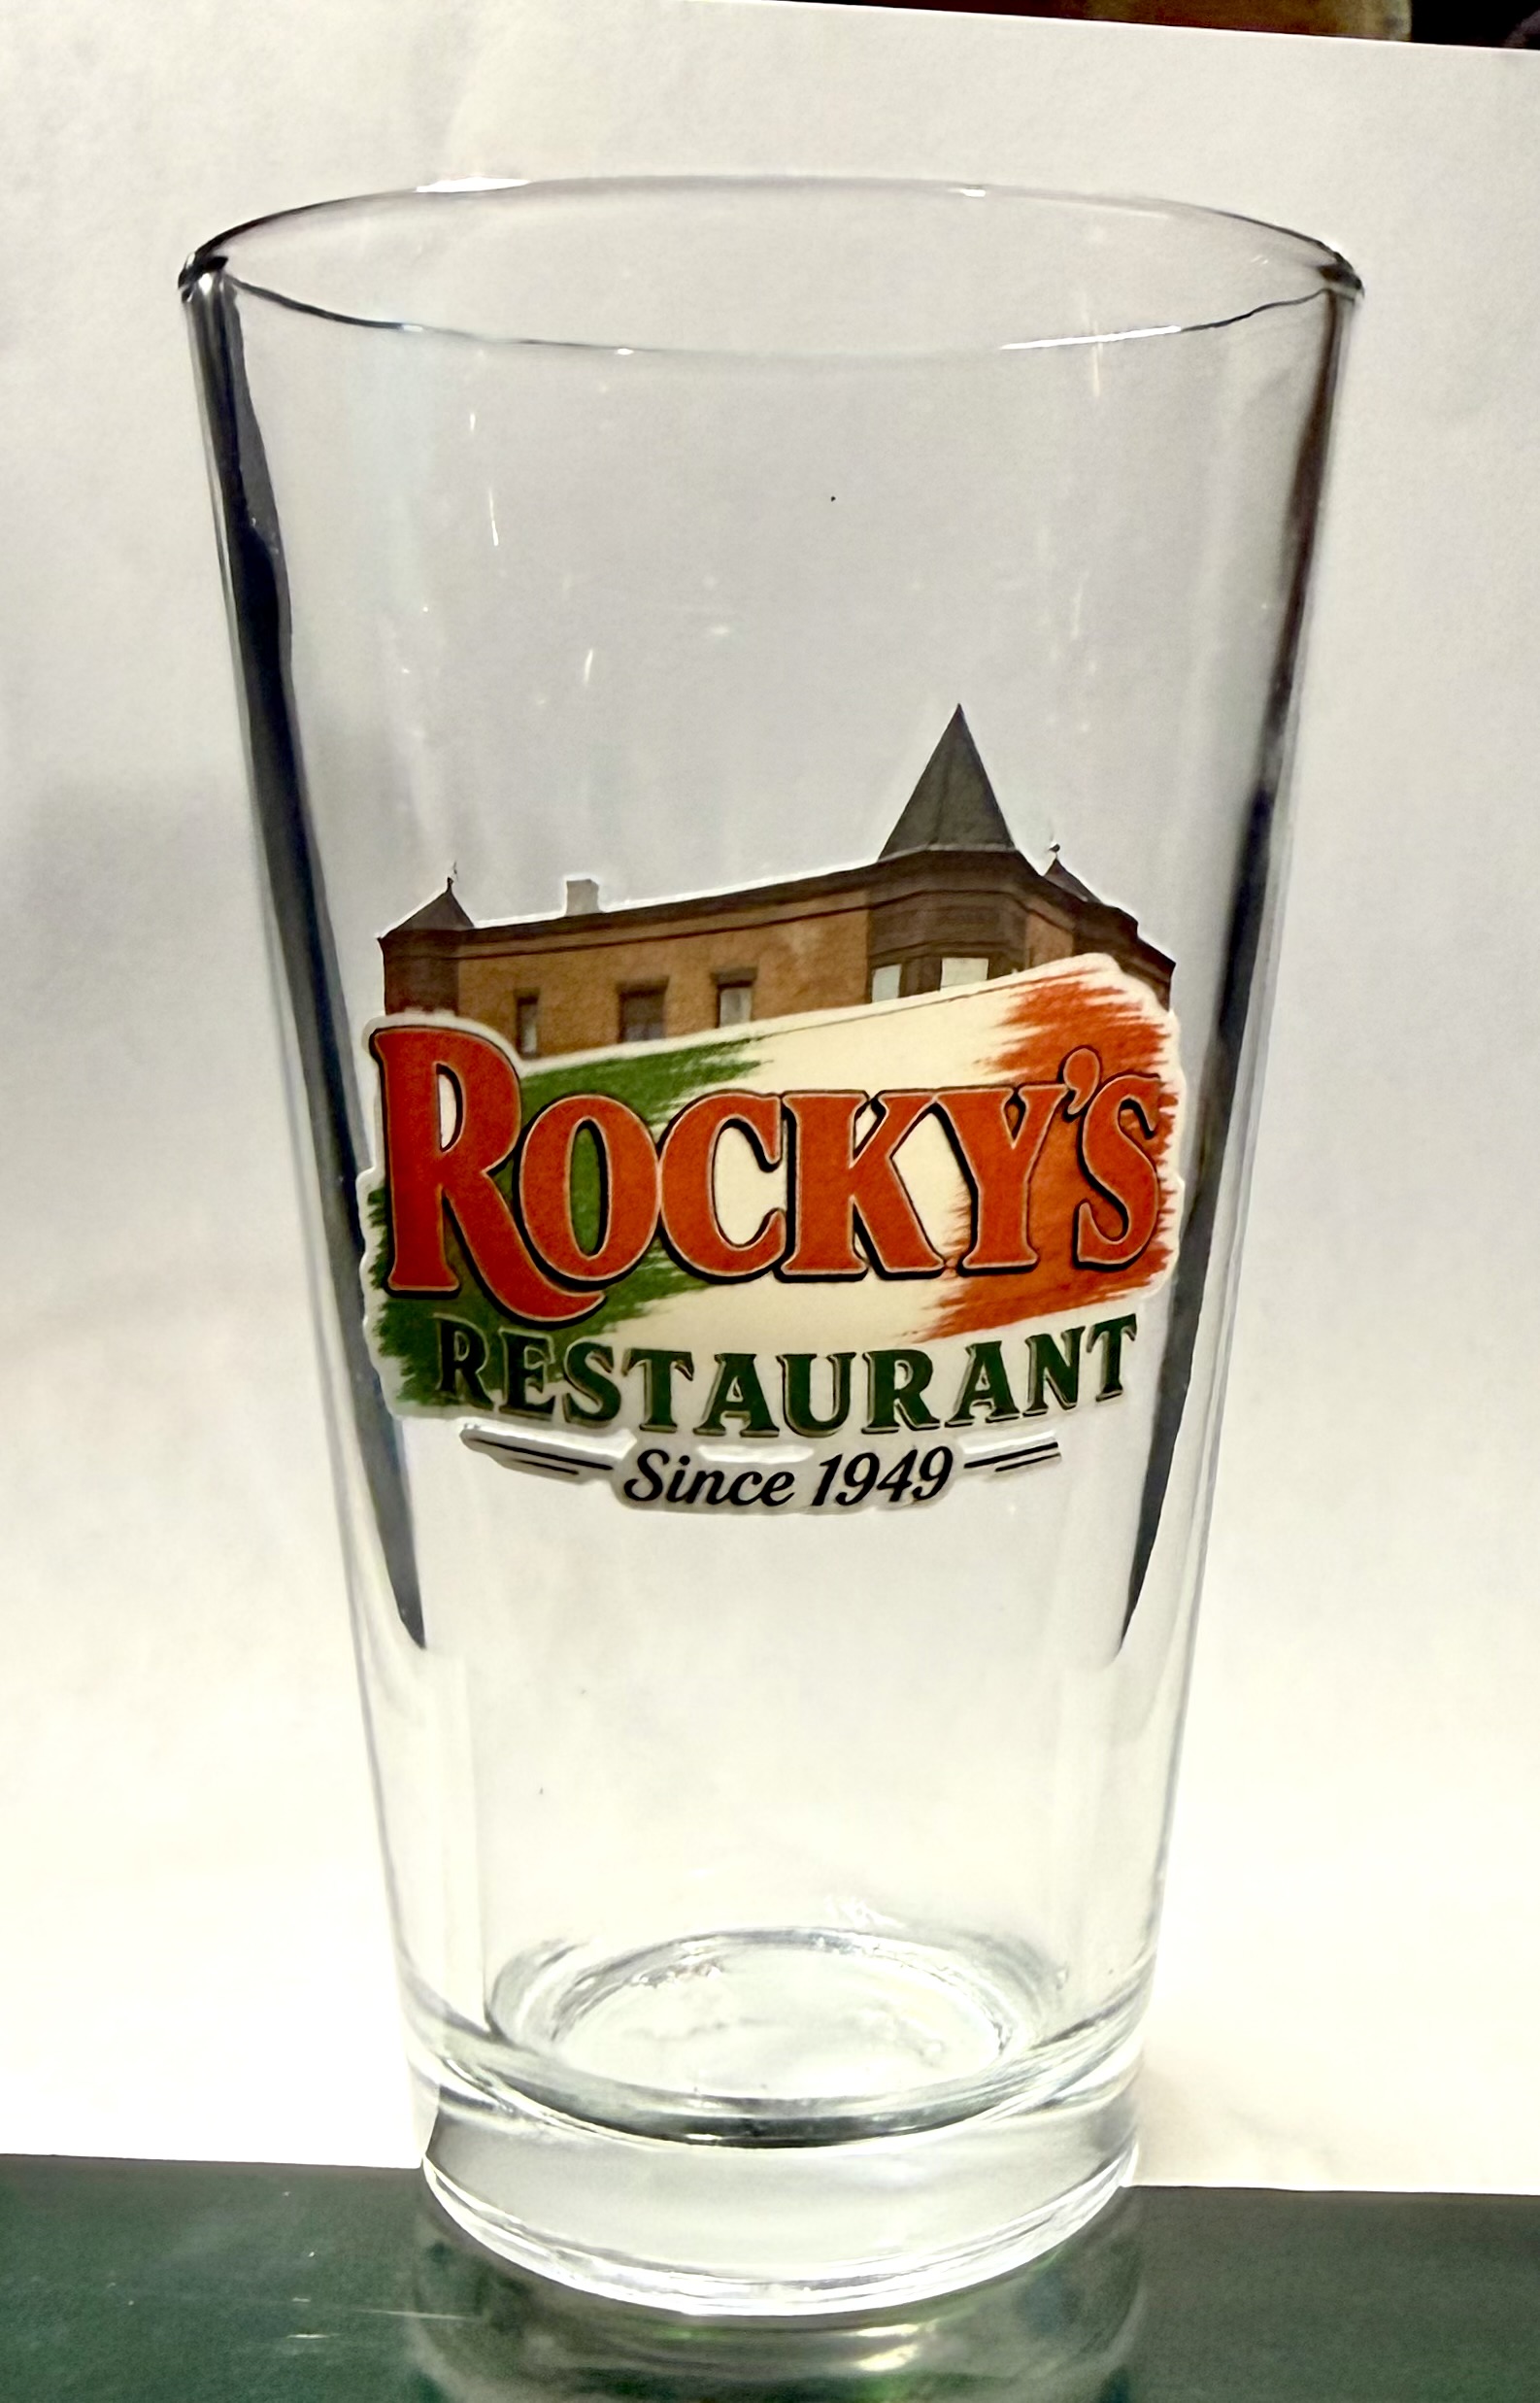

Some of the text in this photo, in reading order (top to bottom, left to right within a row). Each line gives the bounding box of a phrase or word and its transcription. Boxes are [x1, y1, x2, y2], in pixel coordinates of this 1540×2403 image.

[369, 1025, 1162, 1329] ROCKY'S
[436, 1313, 1138, 1438] RESTAURANT
[623, 1445, 954, 1507] Since 1949
